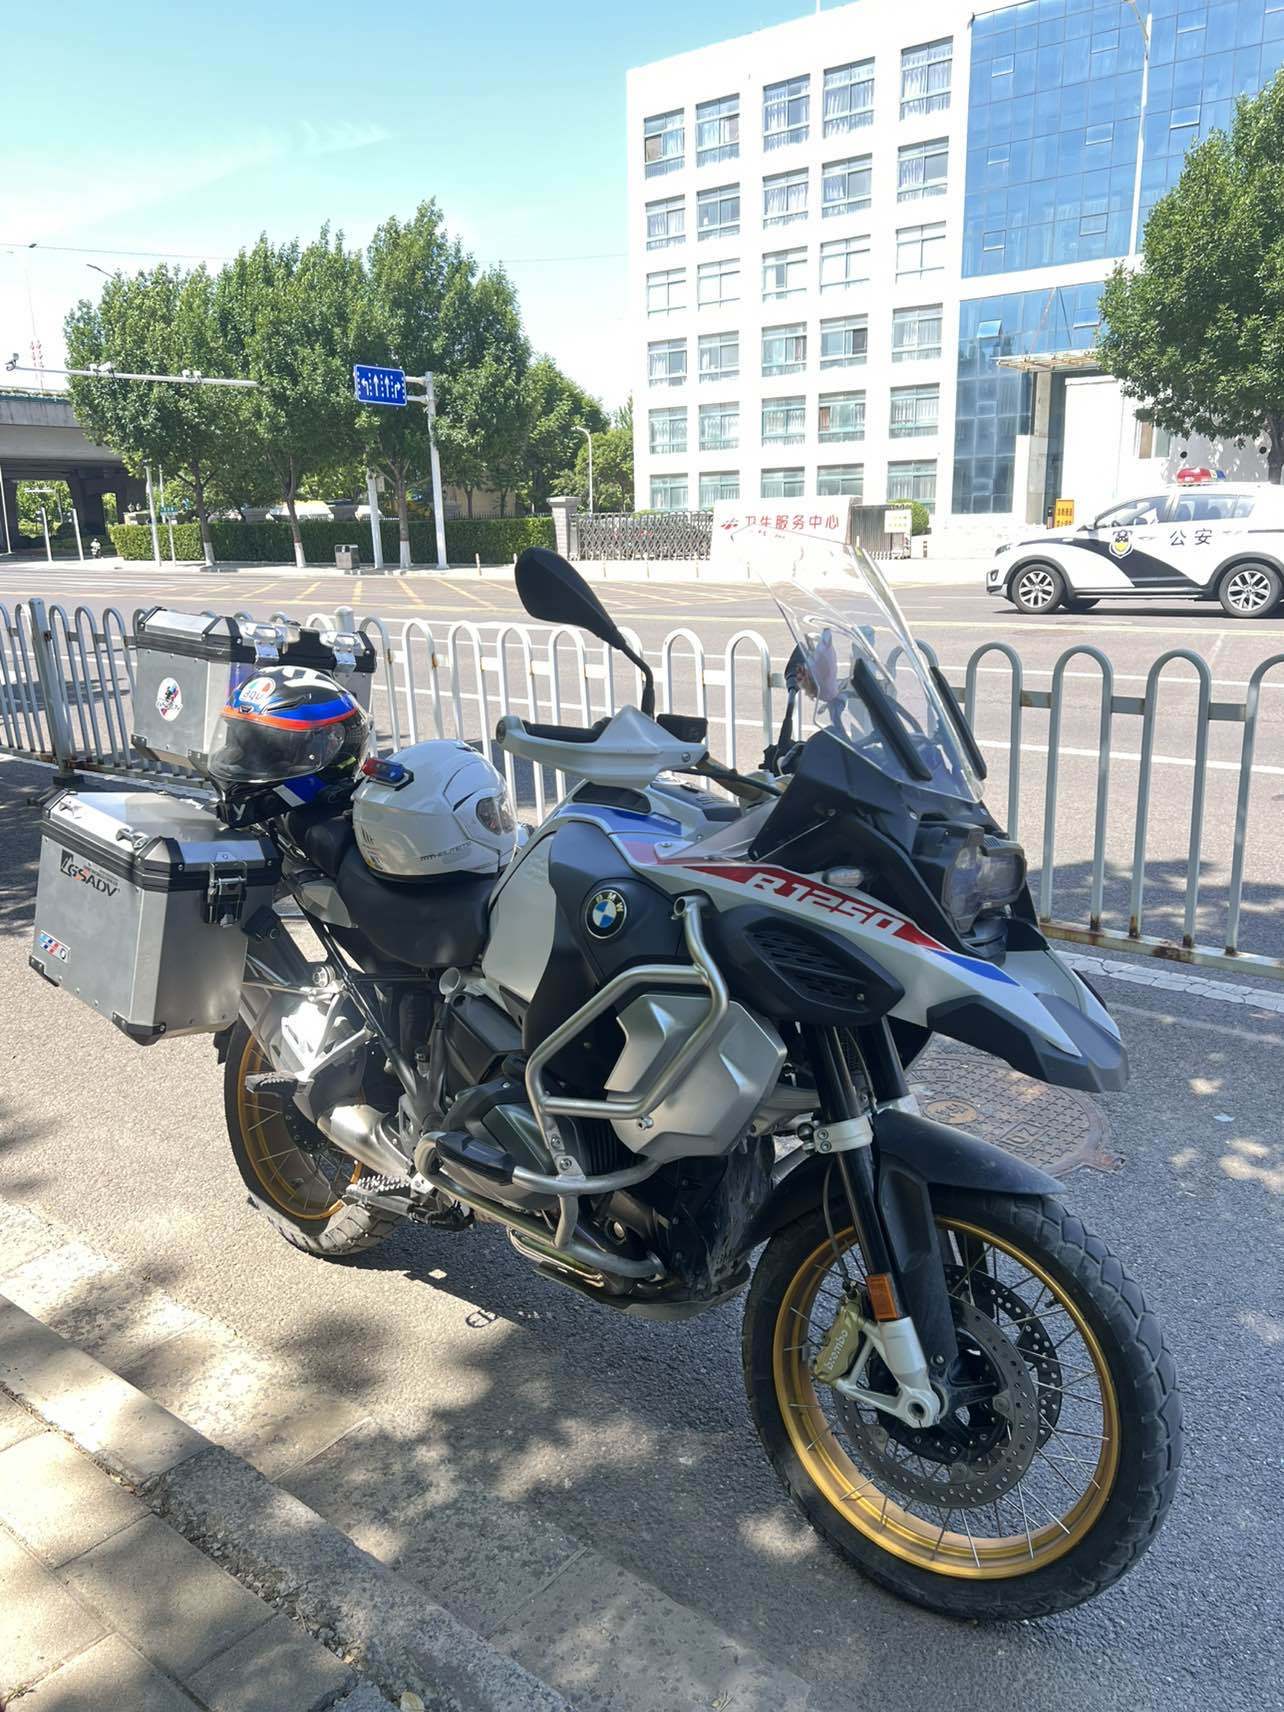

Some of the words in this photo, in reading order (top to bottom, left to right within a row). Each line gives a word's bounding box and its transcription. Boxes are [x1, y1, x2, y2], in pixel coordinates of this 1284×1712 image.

[745, 514, 839, 530] 卫生服务中心
[1169, 528, 1213, 546] 公安
[595, 892, 624, 912] BMW
[826, 1330, 848, 1370] brembo
